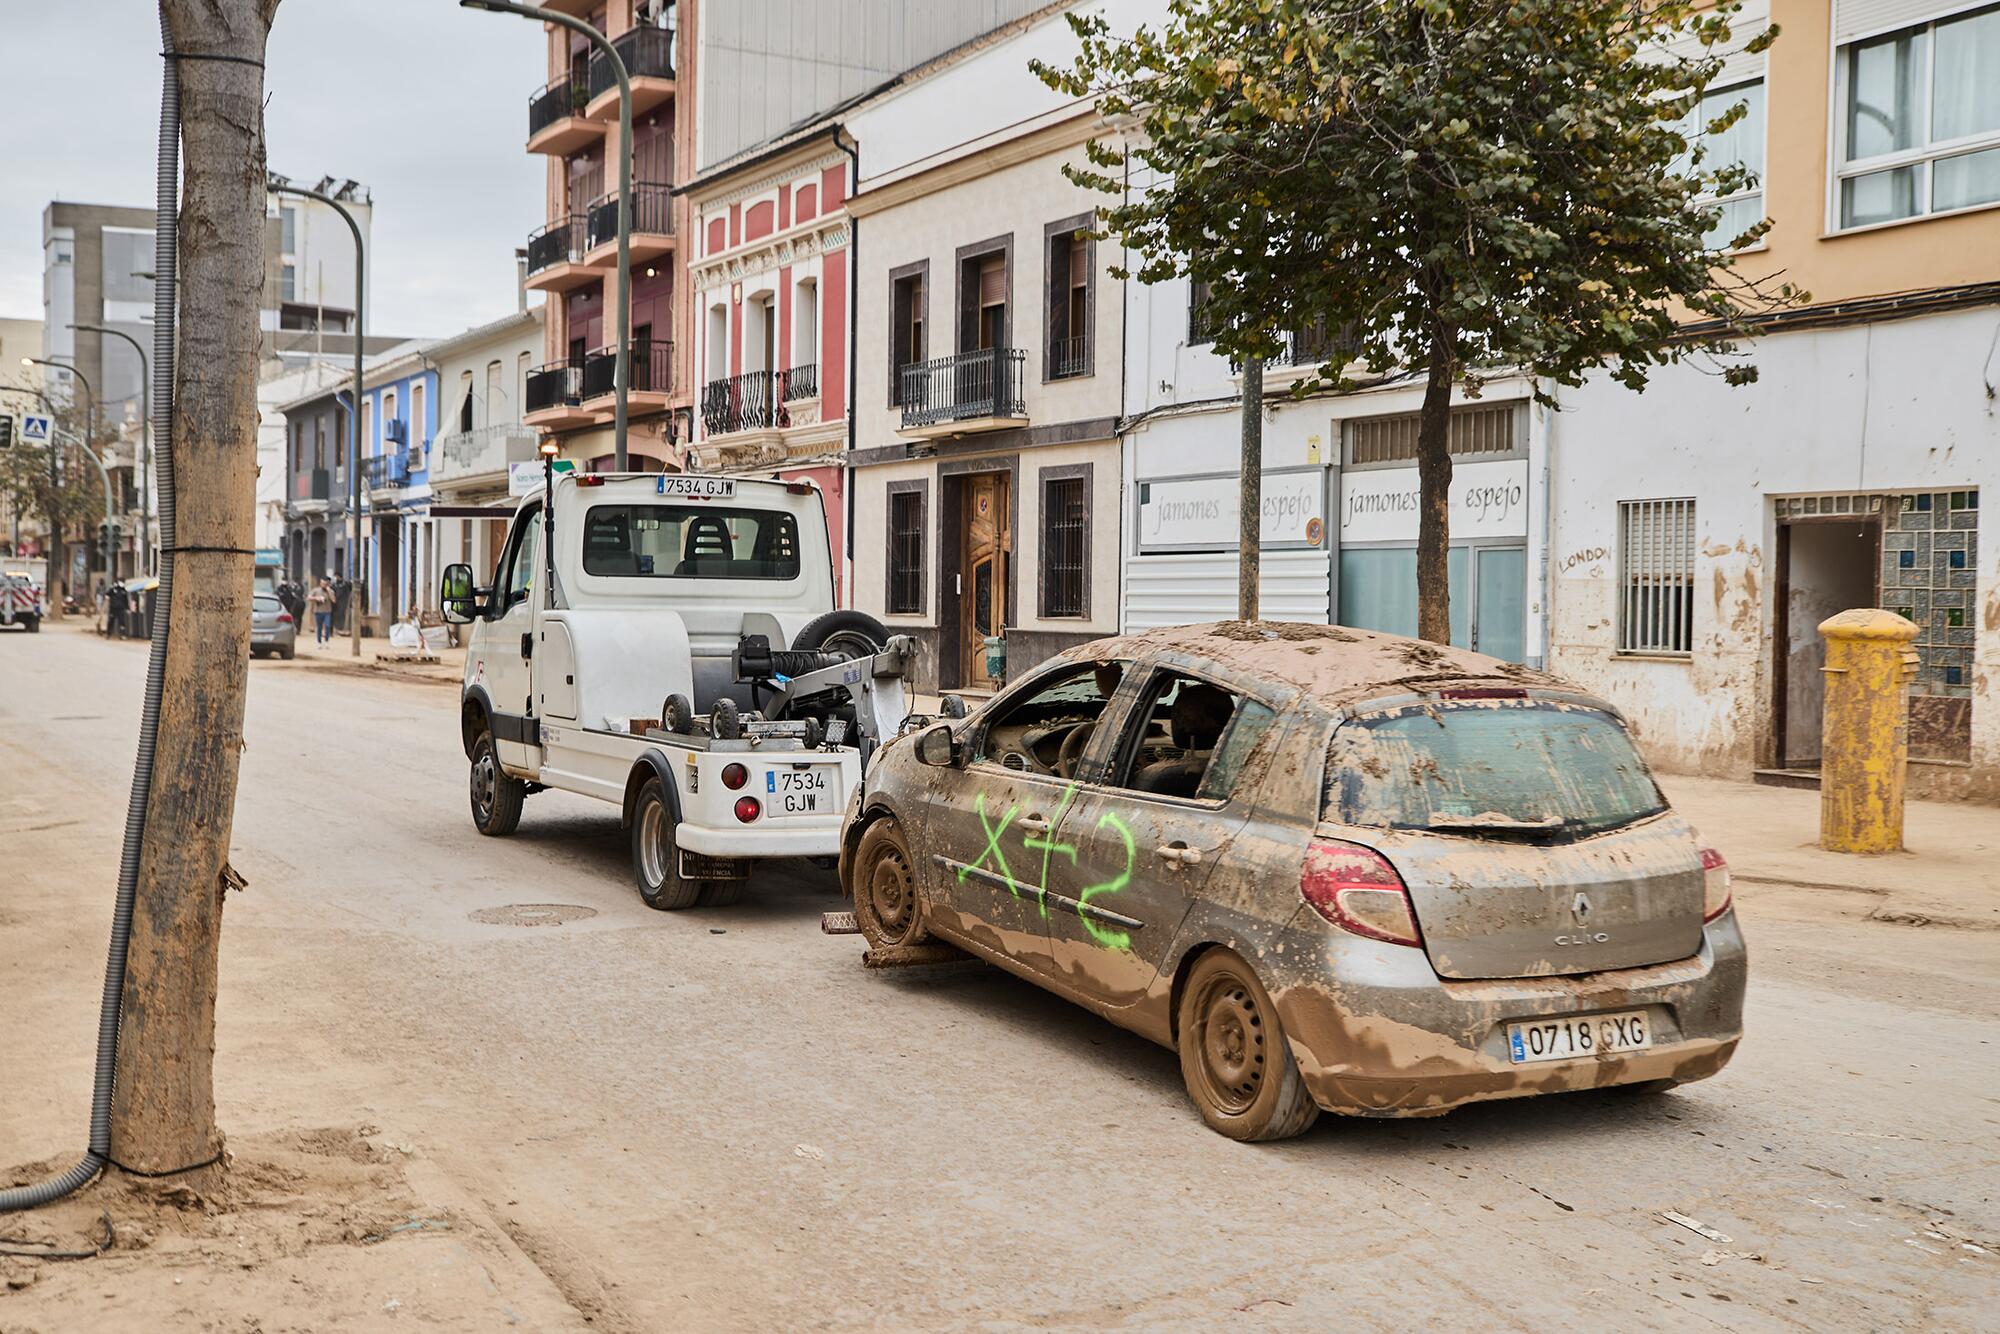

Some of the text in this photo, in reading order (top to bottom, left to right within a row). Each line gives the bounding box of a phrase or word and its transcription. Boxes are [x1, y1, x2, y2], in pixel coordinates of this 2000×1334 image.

[667, 479, 733, 495] 7534 GJW
[1153, 486, 1312, 536] jamones espejo
[1342, 477, 1521, 528] jamones espejo
[1559, 546, 1612, 574] LONDON
[782, 772, 825, 791] 7534
[784, 794, 816, 812] GJW
[1553, 932, 1609, 947] CLIO
[1528, 1021, 1593, 1055] 0718
[1599, 1017, 1644, 1048] GXG
